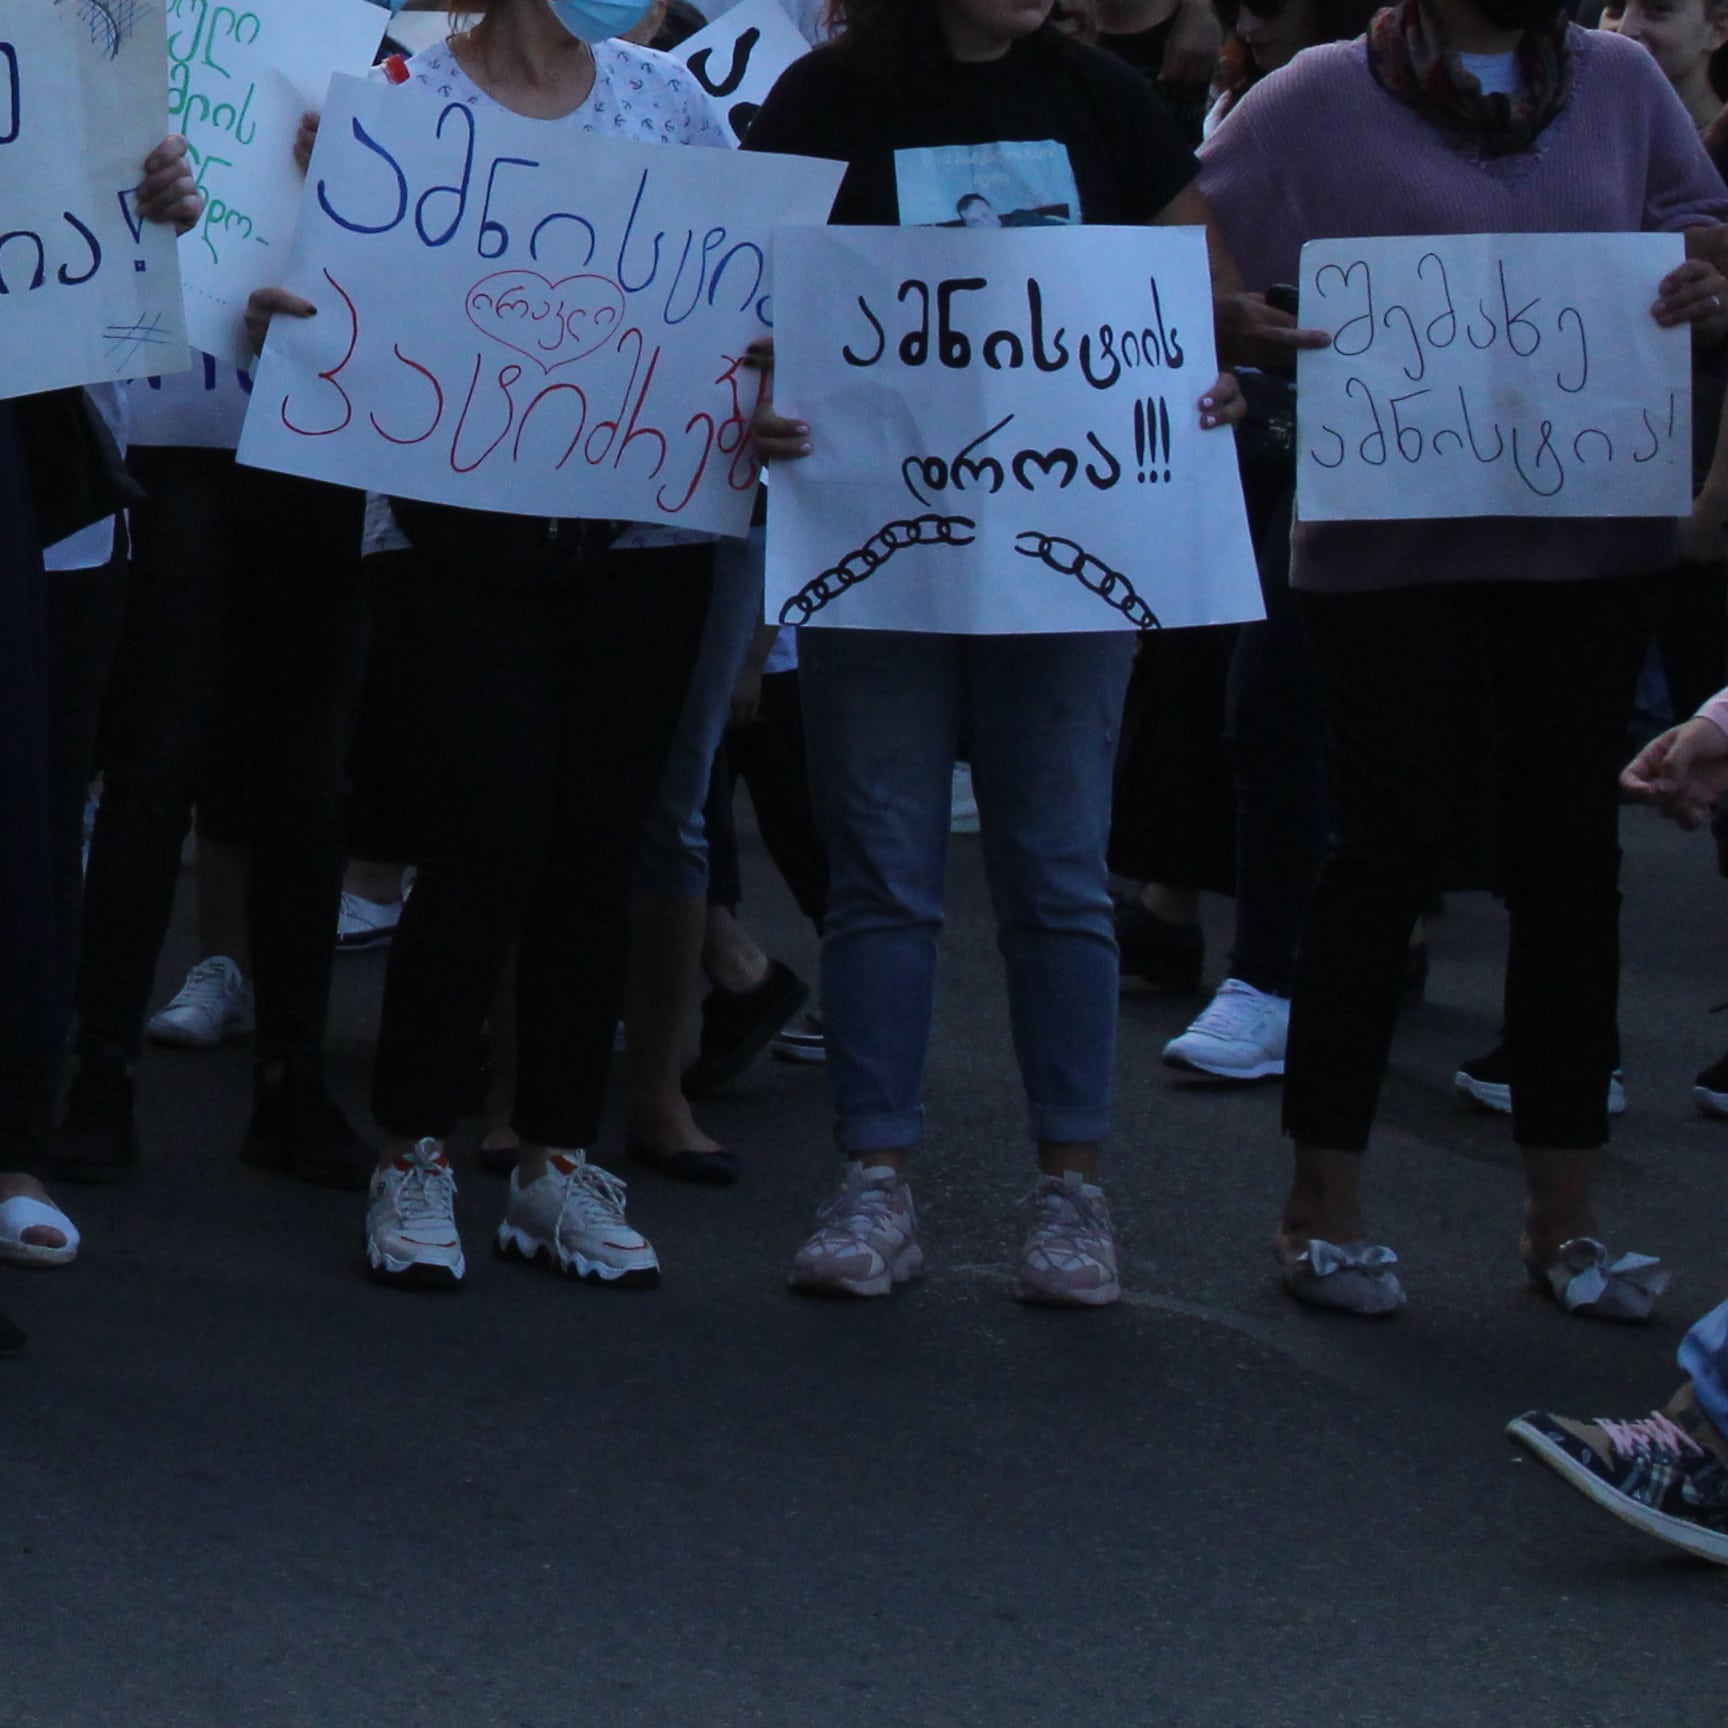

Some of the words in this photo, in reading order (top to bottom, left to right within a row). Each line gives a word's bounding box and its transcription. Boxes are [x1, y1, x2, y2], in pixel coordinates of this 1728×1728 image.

[472, 285, 616, 350] ირაკლი
[842, 276, 1185, 391] ამნისტიის
[1315, 252, 1588, 393] შემახე
[1310, 377, 1677, 497] ამნისტია!
